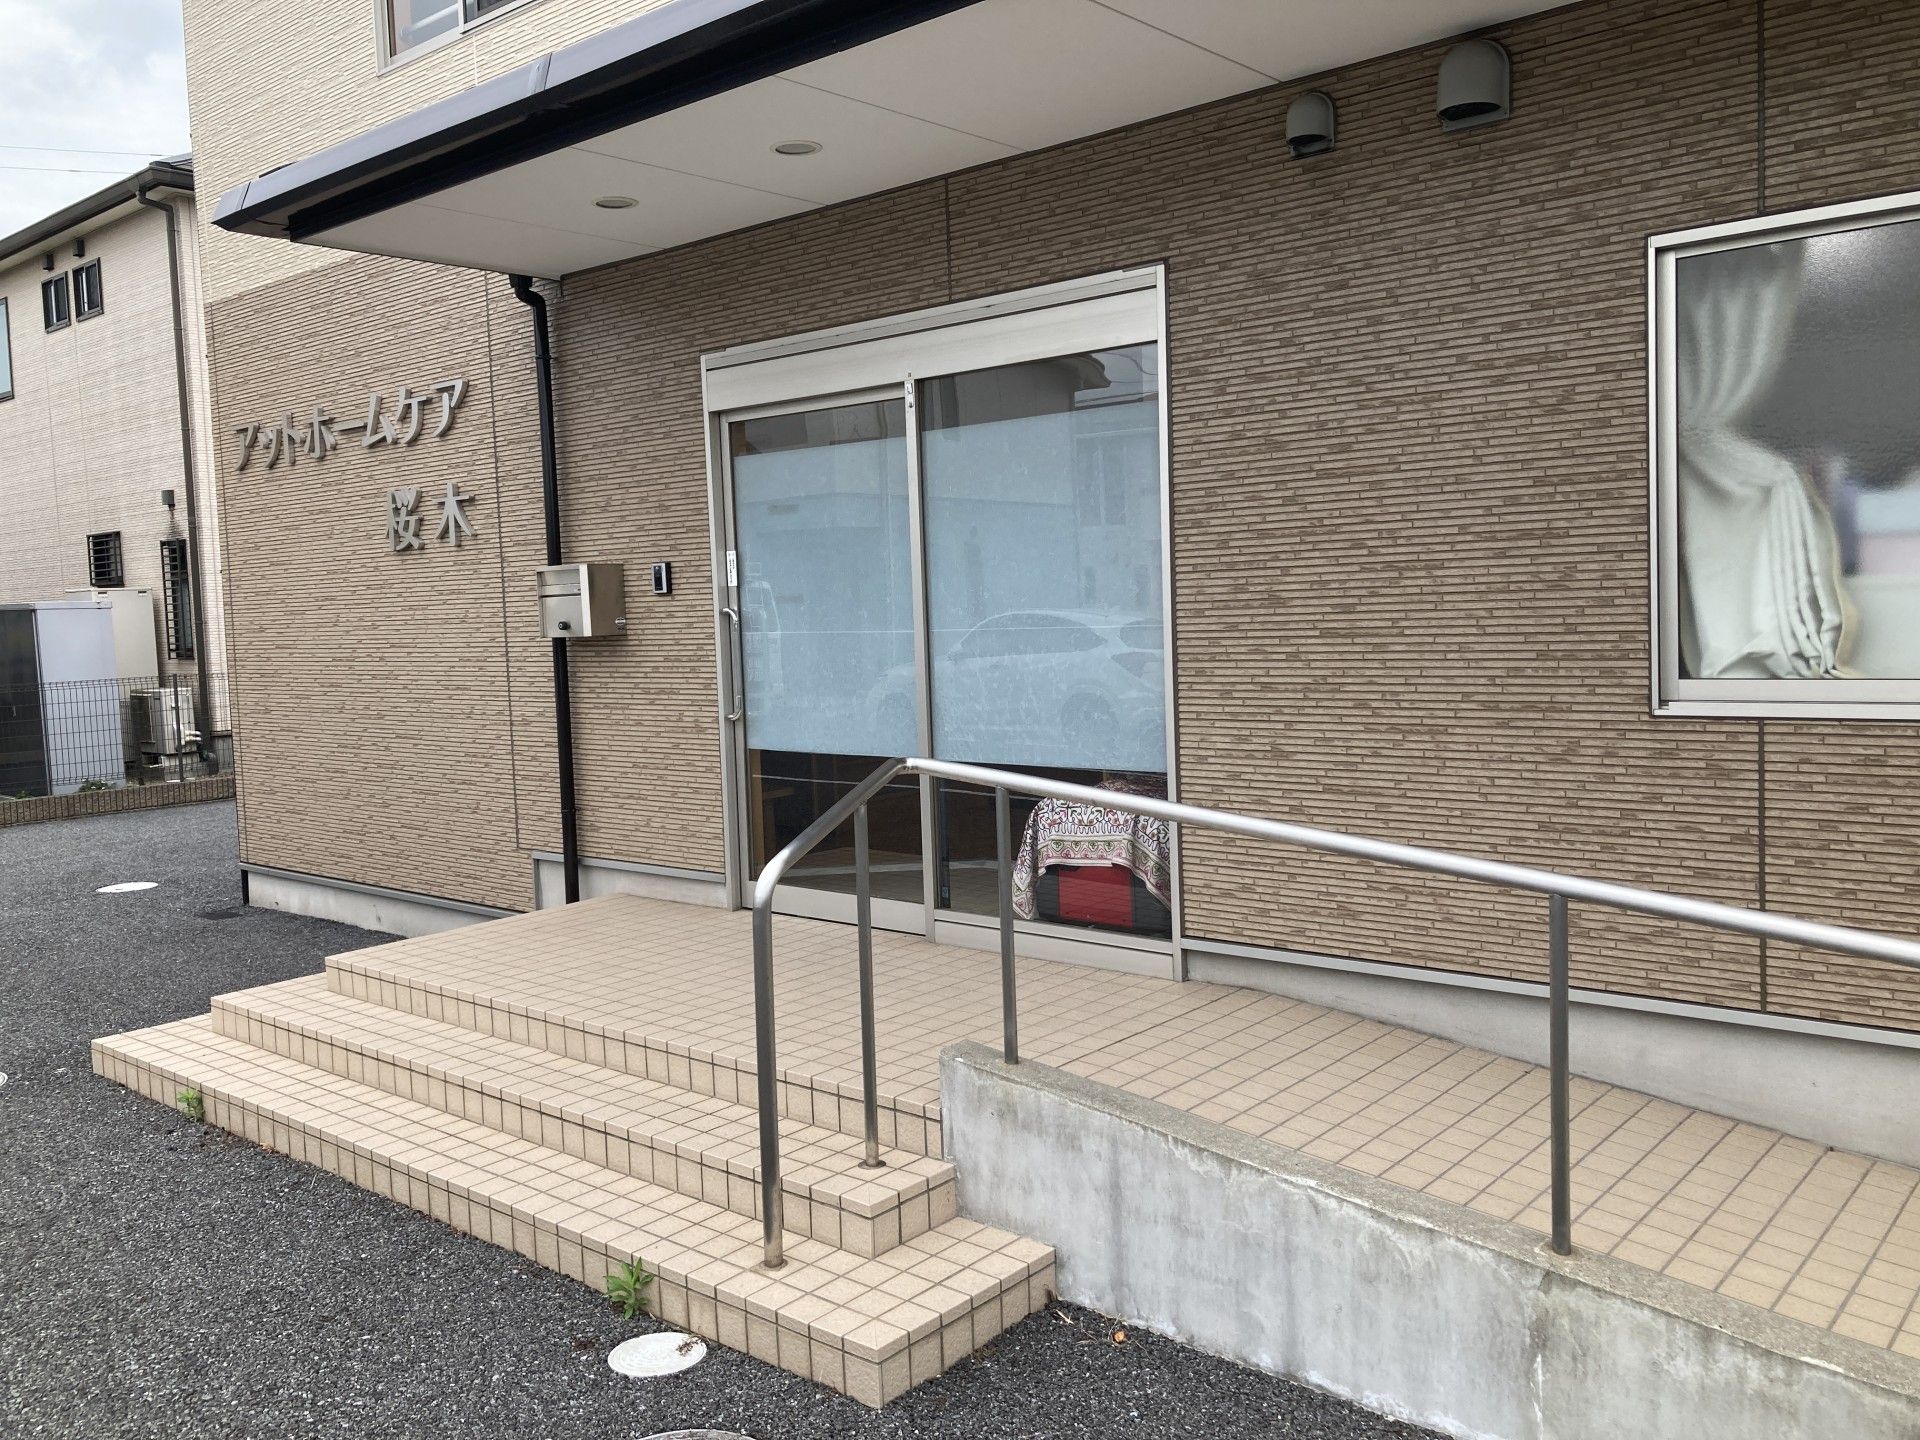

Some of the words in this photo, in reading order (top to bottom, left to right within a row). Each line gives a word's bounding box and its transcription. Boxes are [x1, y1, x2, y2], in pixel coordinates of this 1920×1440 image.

[233, 378, 469, 471] アットホームケア
[386, 481, 475, 551] 桜木
